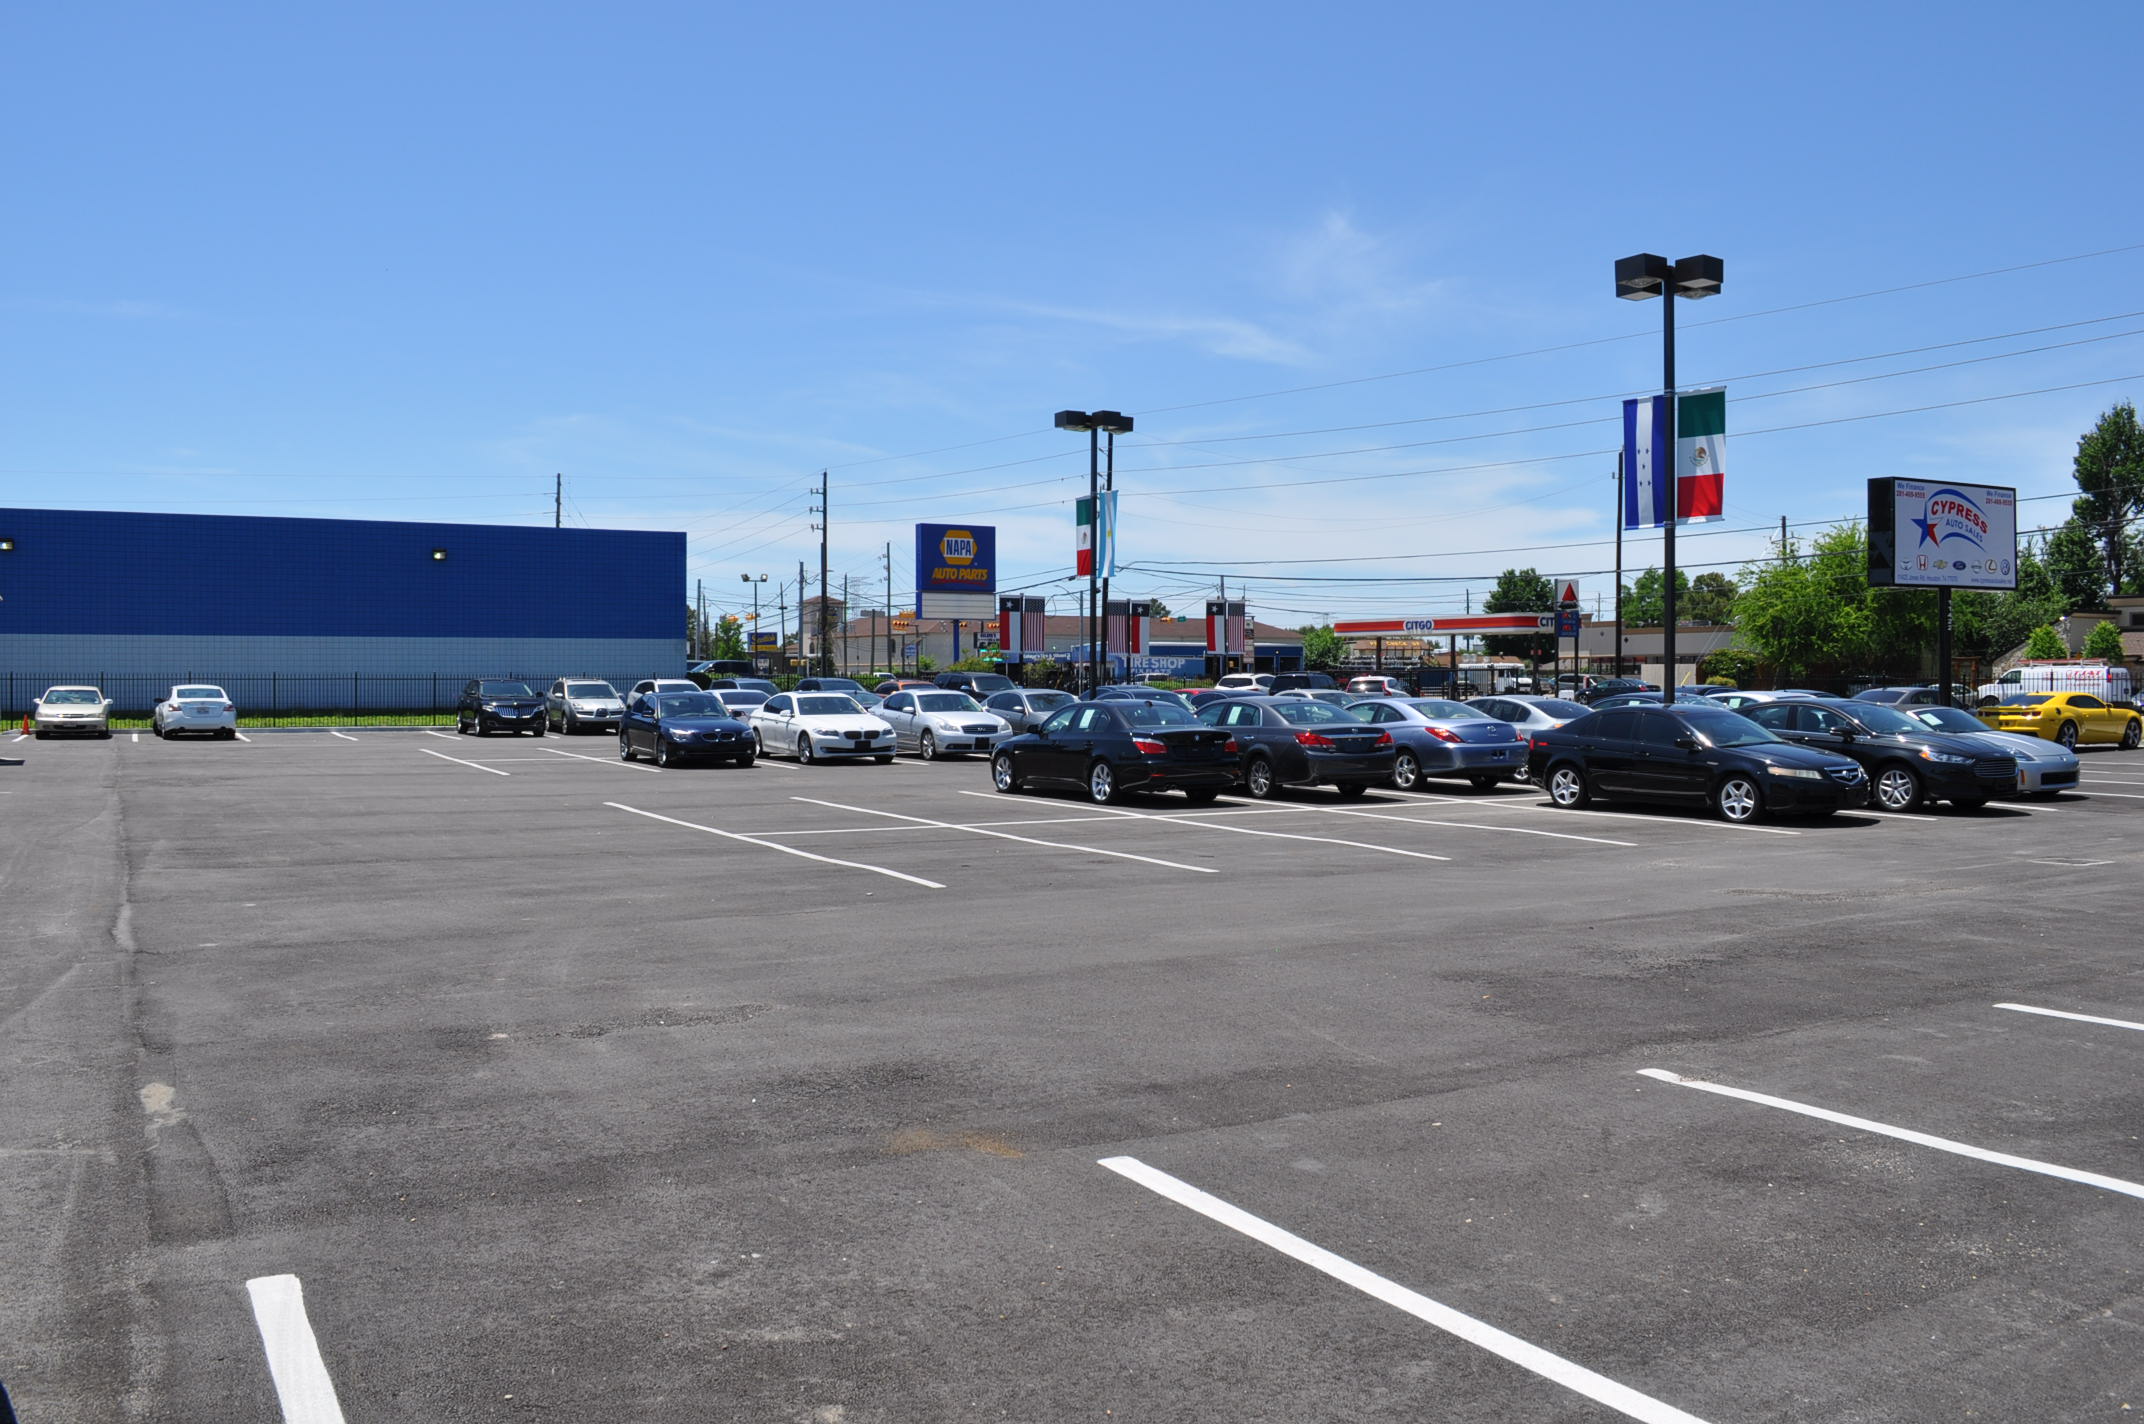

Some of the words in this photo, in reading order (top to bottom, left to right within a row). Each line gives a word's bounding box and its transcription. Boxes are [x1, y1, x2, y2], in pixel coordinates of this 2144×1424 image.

[1931, 501, 1988, 534] CYPRESS
[1945, 518, 1964, 530] AUTO
[1965, 525, 1983, 543] SALES
[945, 539, 972, 556] NAPA
[932, 567, 957, 580] AUTO
[959, 568, 988, 581] PARTS
[1405, 620, 1432, 630] CITGO
[1121, 656, 1149, 668] TIRE
[1150, 657, 1186, 669] SHOP
